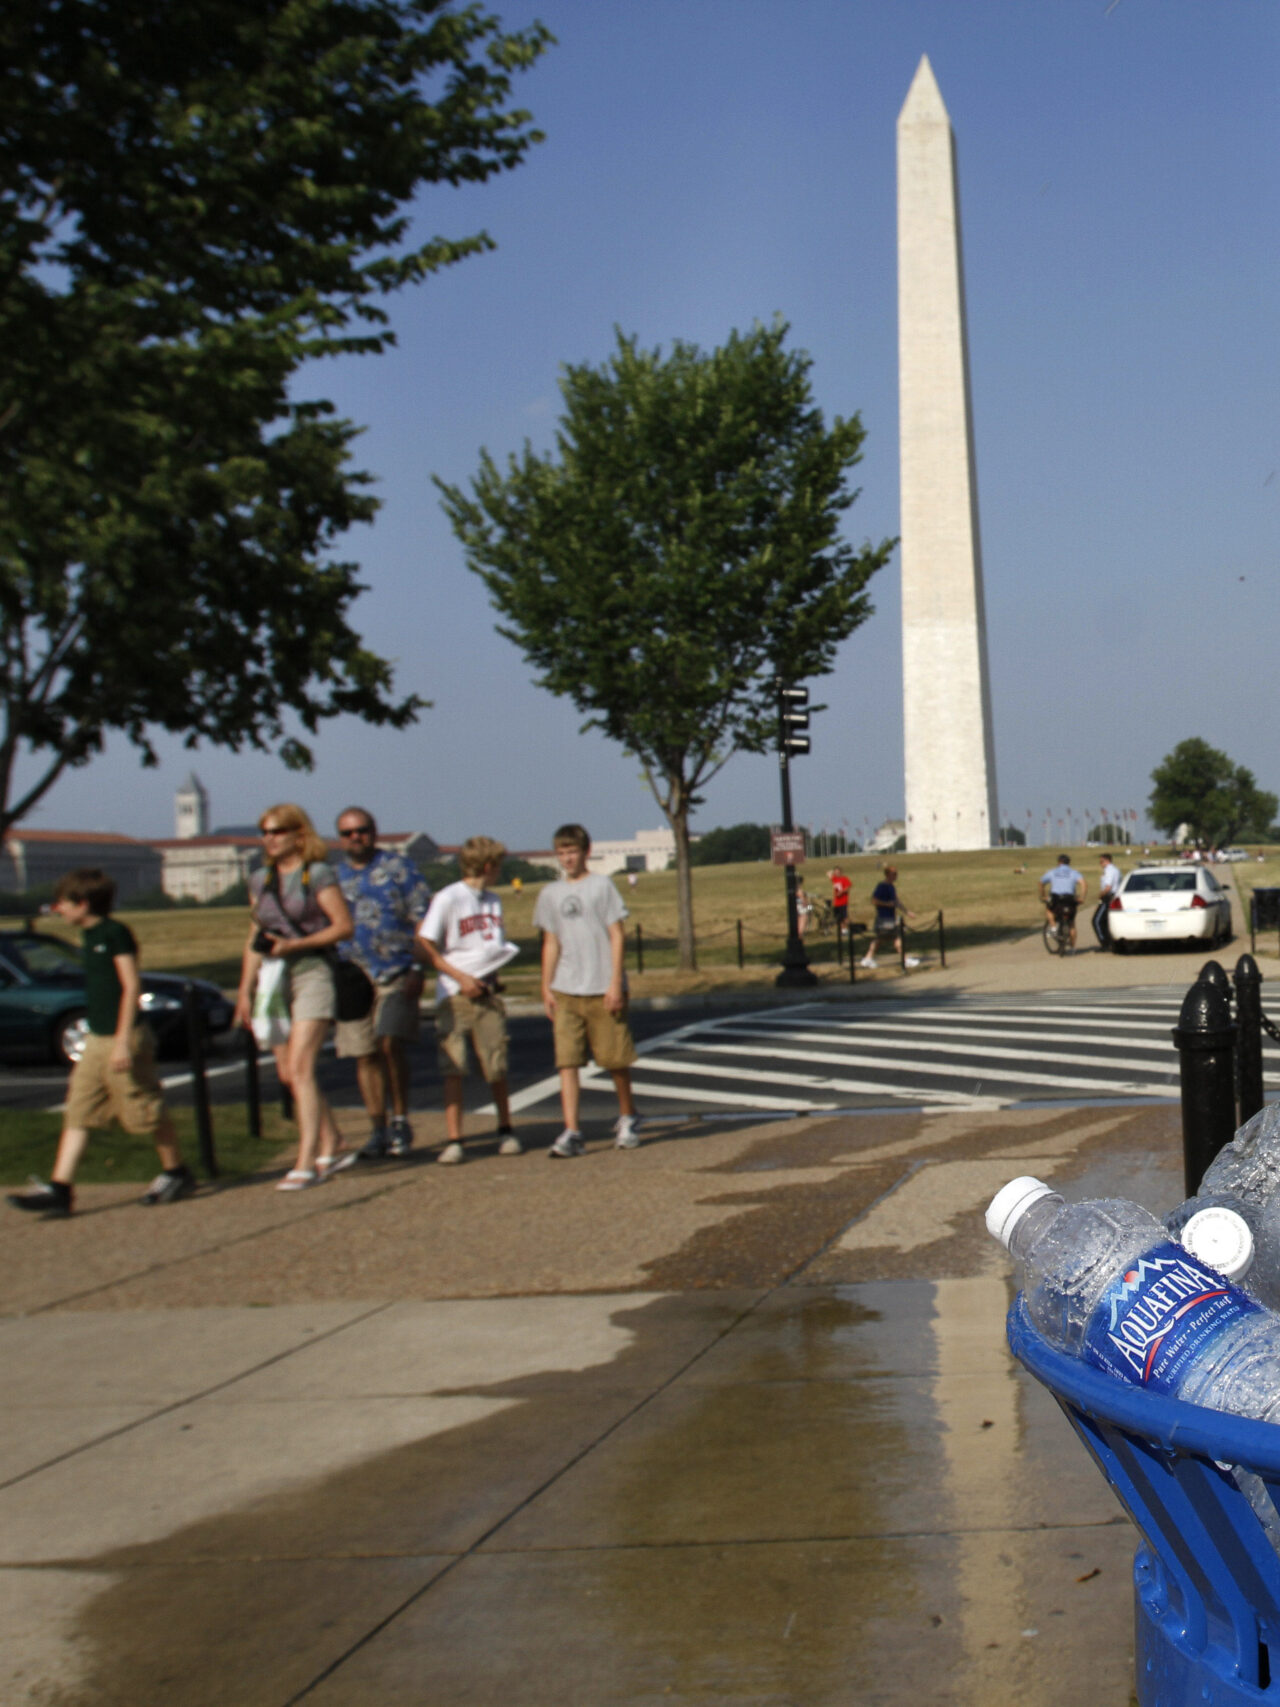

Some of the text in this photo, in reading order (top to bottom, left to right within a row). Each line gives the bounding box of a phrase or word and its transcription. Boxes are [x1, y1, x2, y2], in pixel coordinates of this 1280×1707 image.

[1107, 1258, 1226, 1379] AQUAFINA
[1153, 1357, 1169, 1379] Pure
[1165, 1334, 1188, 1358] Water
[1189, 1306, 1216, 1330] Perfect
[1165, 1349, 1192, 1384] PURIFIED
[1191, 1319, 1222, 1353] DRINKING
